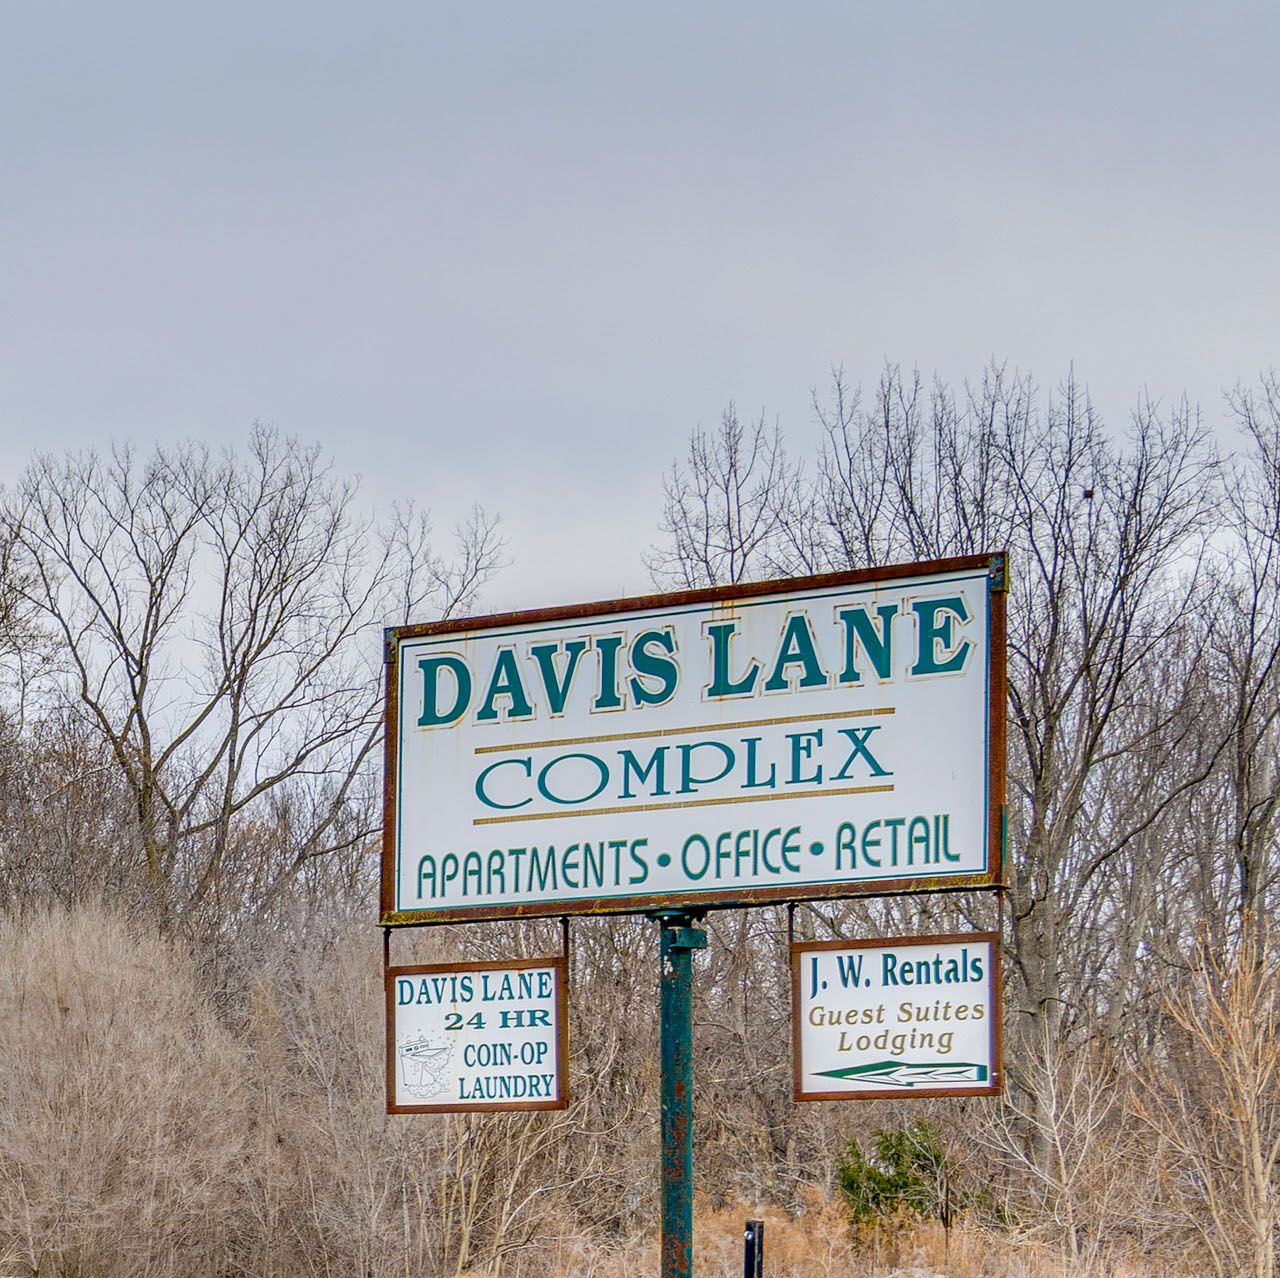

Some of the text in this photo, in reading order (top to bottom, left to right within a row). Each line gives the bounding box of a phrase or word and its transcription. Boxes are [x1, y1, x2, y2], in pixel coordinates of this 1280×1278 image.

[415, 595, 972, 729] DAVIS LANE
[474, 725, 895, 810] COMPLEX
[416, 813, 961, 899] APARTMENTS OFFICE RETAIL
[397, 971, 553, 1006] DAVIS LANE
[809, 948, 984, 1000] J. W. Rentals
[444, 1009, 553, 1031] 24 HR
[808, 1000, 985, 1027] Guest Suites
[463, 1041, 548, 1068] COIN-OP
[836, 1027, 955, 1056] Lodging
[458, 1073, 555, 1100] LAUNDRY
